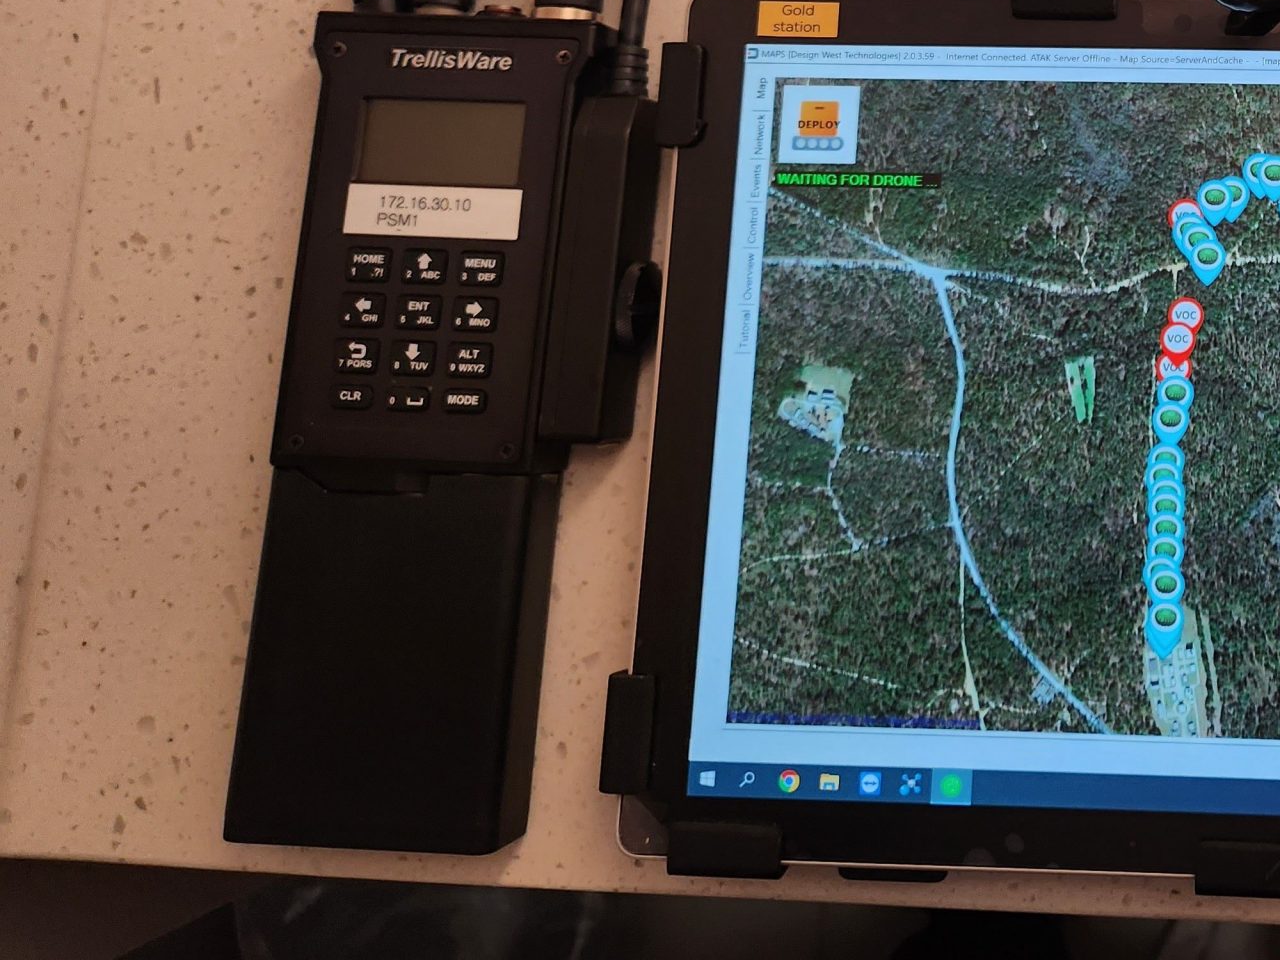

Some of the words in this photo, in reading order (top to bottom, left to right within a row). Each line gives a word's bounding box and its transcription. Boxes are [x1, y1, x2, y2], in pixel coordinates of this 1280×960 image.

[782, 4, 815, 16] Gold
[773, 20, 821, 33] station
[391, 48, 513, 71] TrellisWare
[761, 50, 786, 59] MAPS
[821, 51, 842, 59] West
[903, 52, 935, 61] 2.0.3.59
[946, 53, 979, 61] Internet
[1030, 54, 1051, 62] ATAK
[1053, 55, 1080, 63] Server
[1082, 55, 1111, 63] Offline
[1120, 55, 1139, 65] Map
[756, 77, 767, 100] Map
[798, 120, 841, 130] DEPLOY
[755, 114, 767, 156] Network
[751, 164, 762, 198] Events
[777, 173, 838, 186] WAITING
[840, 174, 870, 186] FOR
[872, 175, 923, 187] DRONE
[380, 195, 472, 212] 172.16.30.10
[376, 212, 418, 227] PSM1
[749, 207, 760, 244] Control
[353, 254, 385, 265] HOME
[464, 258, 497, 269] MENU
[351, 267, 357, 276] 1
[405, 270, 412, 279] 2
[421, 271, 441, 280] ABC
[743, 253, 755, 300] Overview
[462, 272, 468, 281] 3
[477, 272, 497, 282] DEF
[408, 301, 431, 311] ENT
[361, 314, 378, 322] GHI
[400, 315, 406, 323] 5
[416, 316, 434, 325] JKL
[1175, 311, 1197, 320] VOC
[455, 318, 462, 326] 6
[469, 318, 491, 327] MNO
[739, 309, 750, 348] Tutorial
[1167, 334, 1189, 344] VOC
[459, 349, 480, 359] ALT
[338, 359, 344, 367] 7
[346, 359, 373, 368] PQRS
[394, 361, 400, 369] 8
[410, 361, 429, 370] TUV
[450, 363, 456, 371] 9
[458, 363, 486, 373] WXYZ
[339, 391, 362, 401] CLR
[389, 396, 395, 405] 0
[447, 394, 480, 405] MODE
